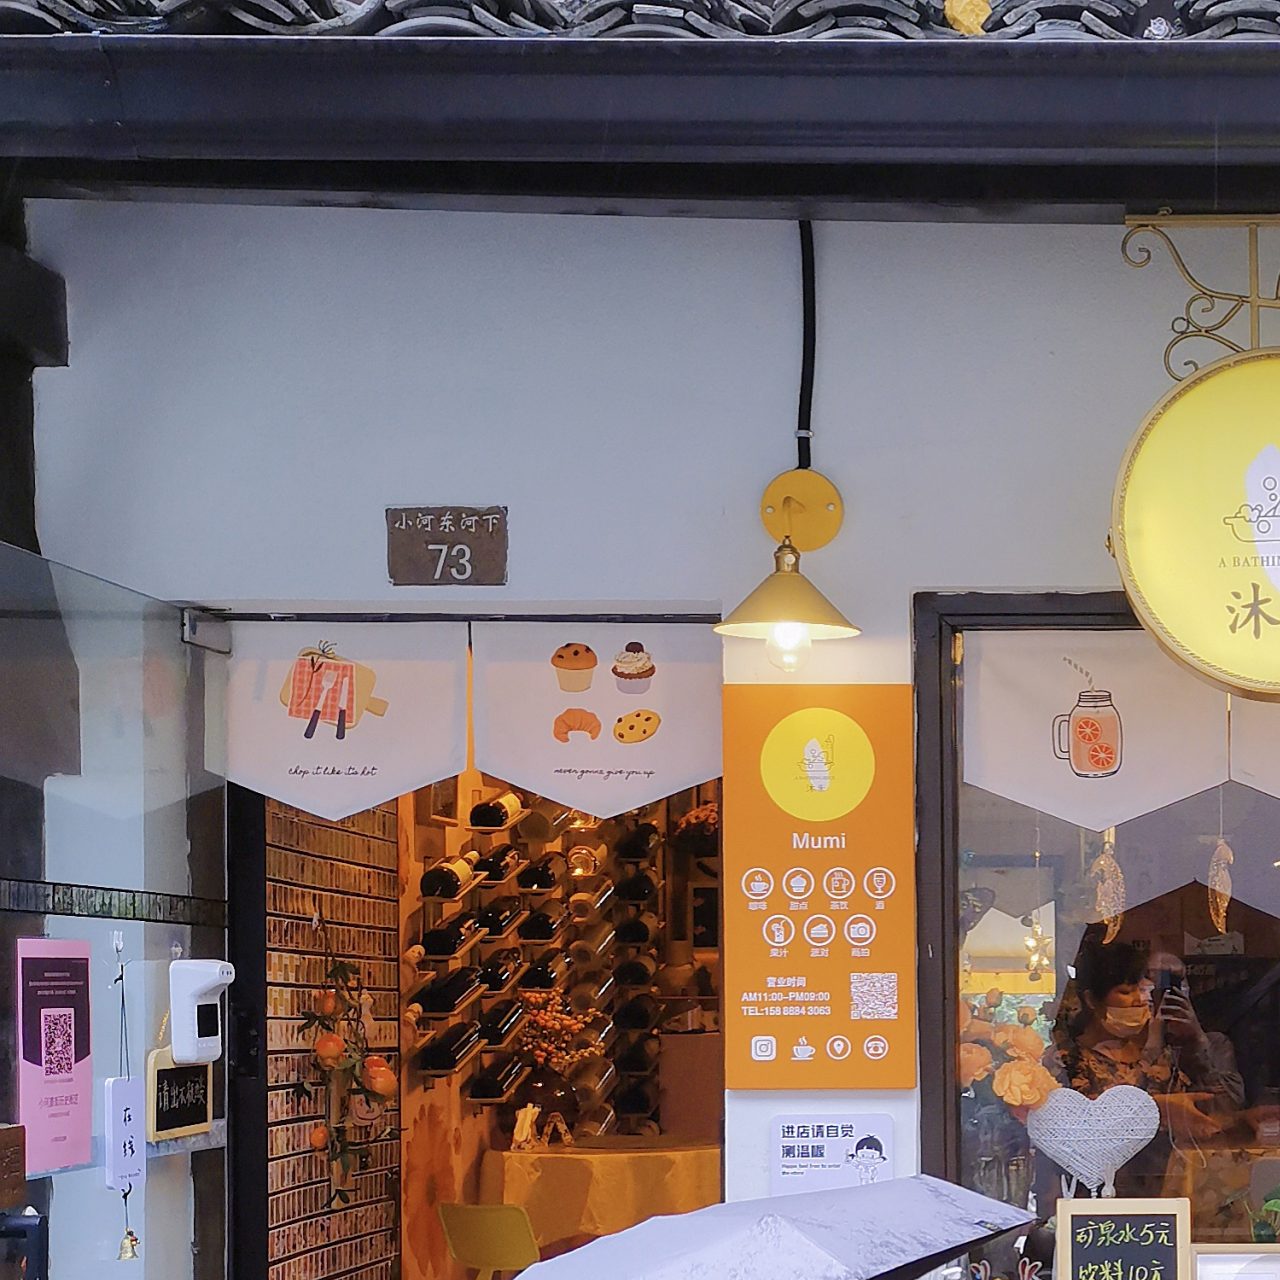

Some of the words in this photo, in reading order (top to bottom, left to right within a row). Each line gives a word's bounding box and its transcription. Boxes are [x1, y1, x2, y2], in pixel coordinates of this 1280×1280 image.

[395, 511, 500, 532] 小河东河下
[427, 544, 472, 580] 73
[1218, 557, 1227, 568] A
[288, 765, 309, 779] chop
[323, 766, 342, 776] like
[360, 766, 377, 776] hot
[577, 768, 604, 780] gonna
[604, 768, 624, 780] give
[624, 770, 642, 780] you
[643, 771, 655, 779] up
[792, 832, 846, 849] Mumi
[767, 976, 806, 987] 营业时间
[782, 1124, 854, 1138] 进店请自觉
[1076, 1220, 1174, 1248] 矿泉水5元
